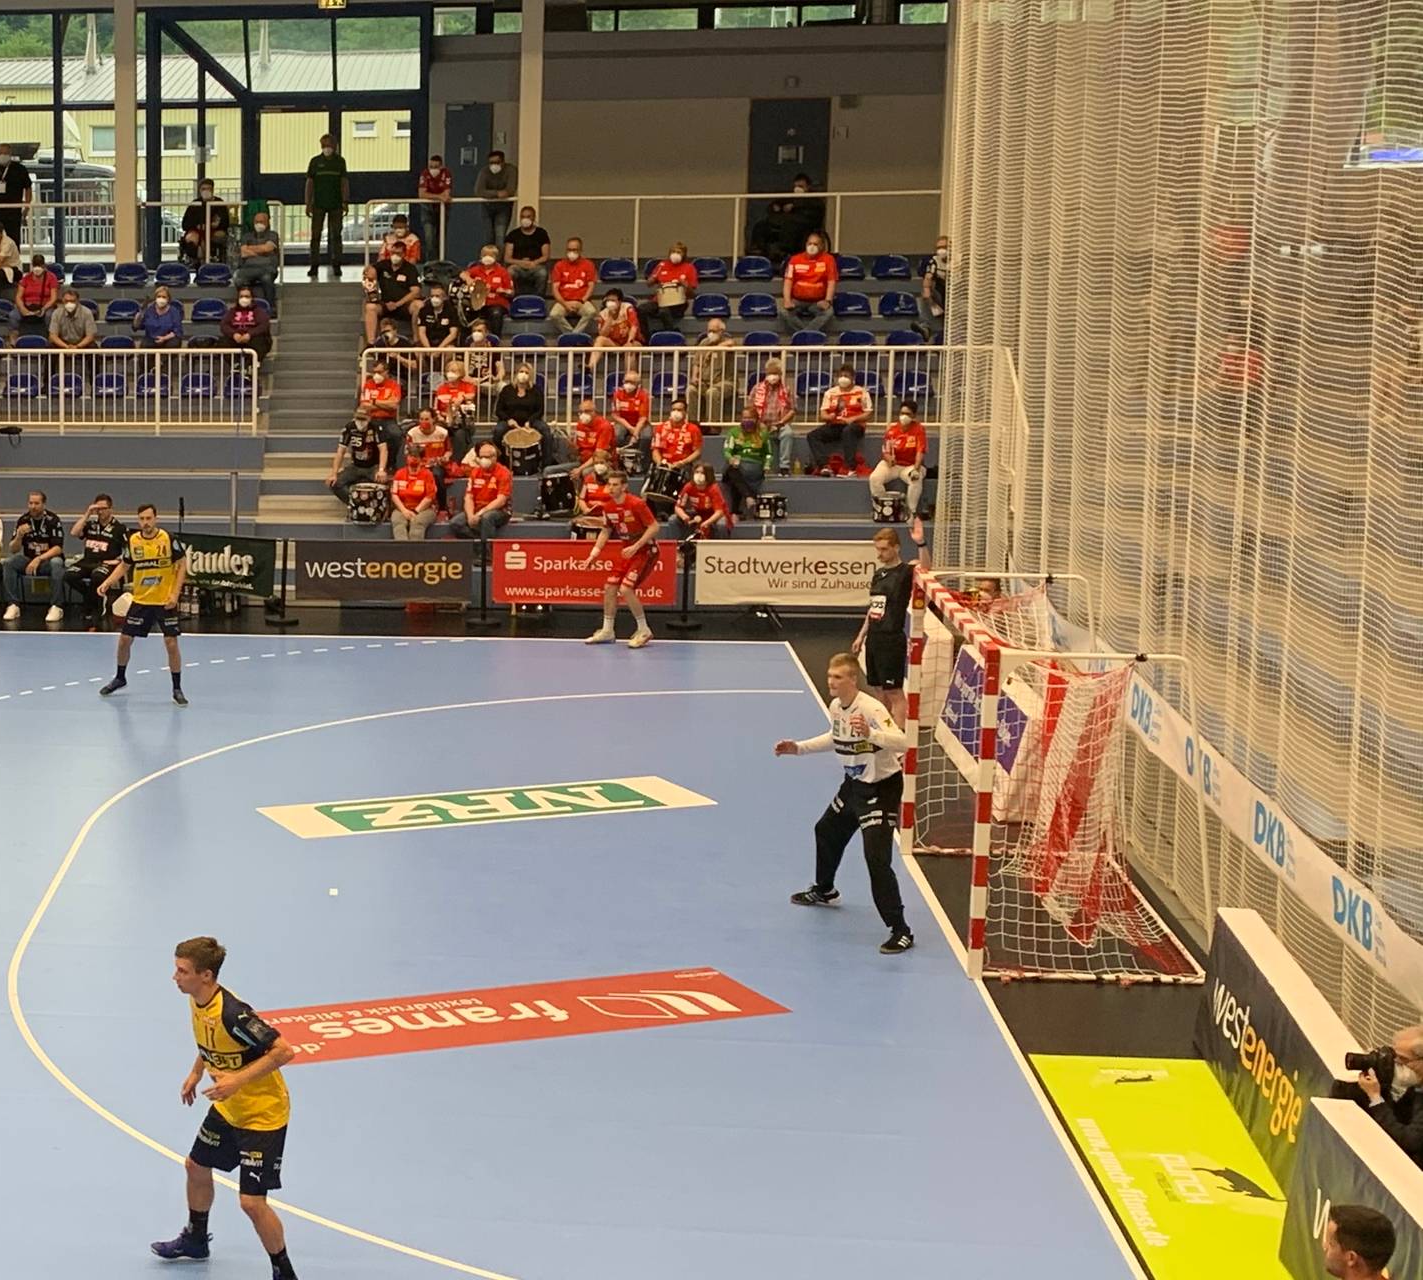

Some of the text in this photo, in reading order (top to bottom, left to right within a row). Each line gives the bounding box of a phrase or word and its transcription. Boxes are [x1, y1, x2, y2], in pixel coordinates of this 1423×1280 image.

[181, 543, 255, 577] tauder
[304, 555, 463, 585] westenergie
[704, 555, 877, 576] Stadtwerkessen
[504, 585, 663, 599] www.sparkasse-n.de
[767, 577, 788, 589] Wir
[791, 577, 817, 590] sind
[332, 783, 646, 828] NRZ
[1253, 800, 1286, 868] DKB
[1331, 875, 1373, 952] DKB
[308, 998, 571, 1040] frames
[345, 1009, 363, 1019] &
[359, 996, 484, 1020] textildruck
[1212, 976, 1304, 1144] westenergie
